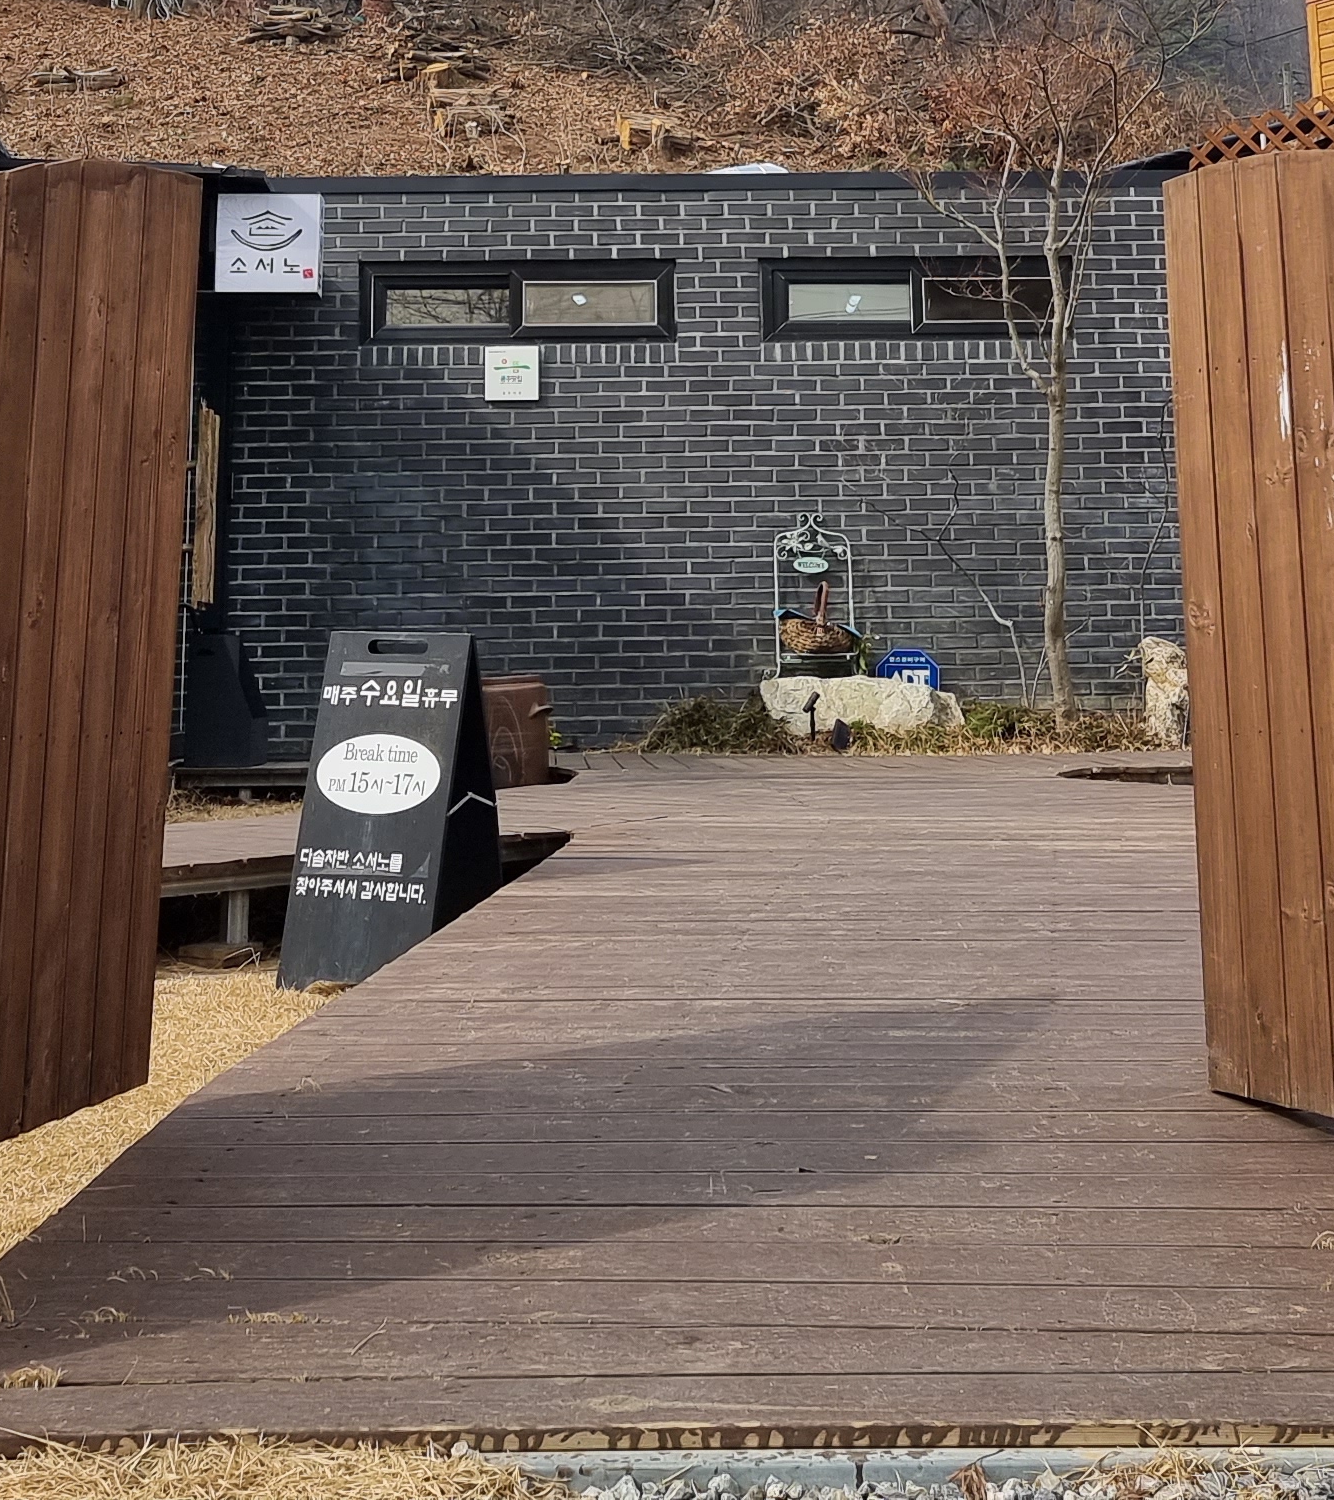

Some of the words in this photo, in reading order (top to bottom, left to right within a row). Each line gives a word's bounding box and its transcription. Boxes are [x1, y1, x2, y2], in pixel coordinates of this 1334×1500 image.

[230, 257, 301, 273] 소서노
[343, 742, 385, 762] Break
[387, 745, 419, 763] time
[351, 851, 403, 873] 소서노를
[295, 875, 359, 900] 찾아주셔서
[360, 880, 427, 905] 감사합니다.
